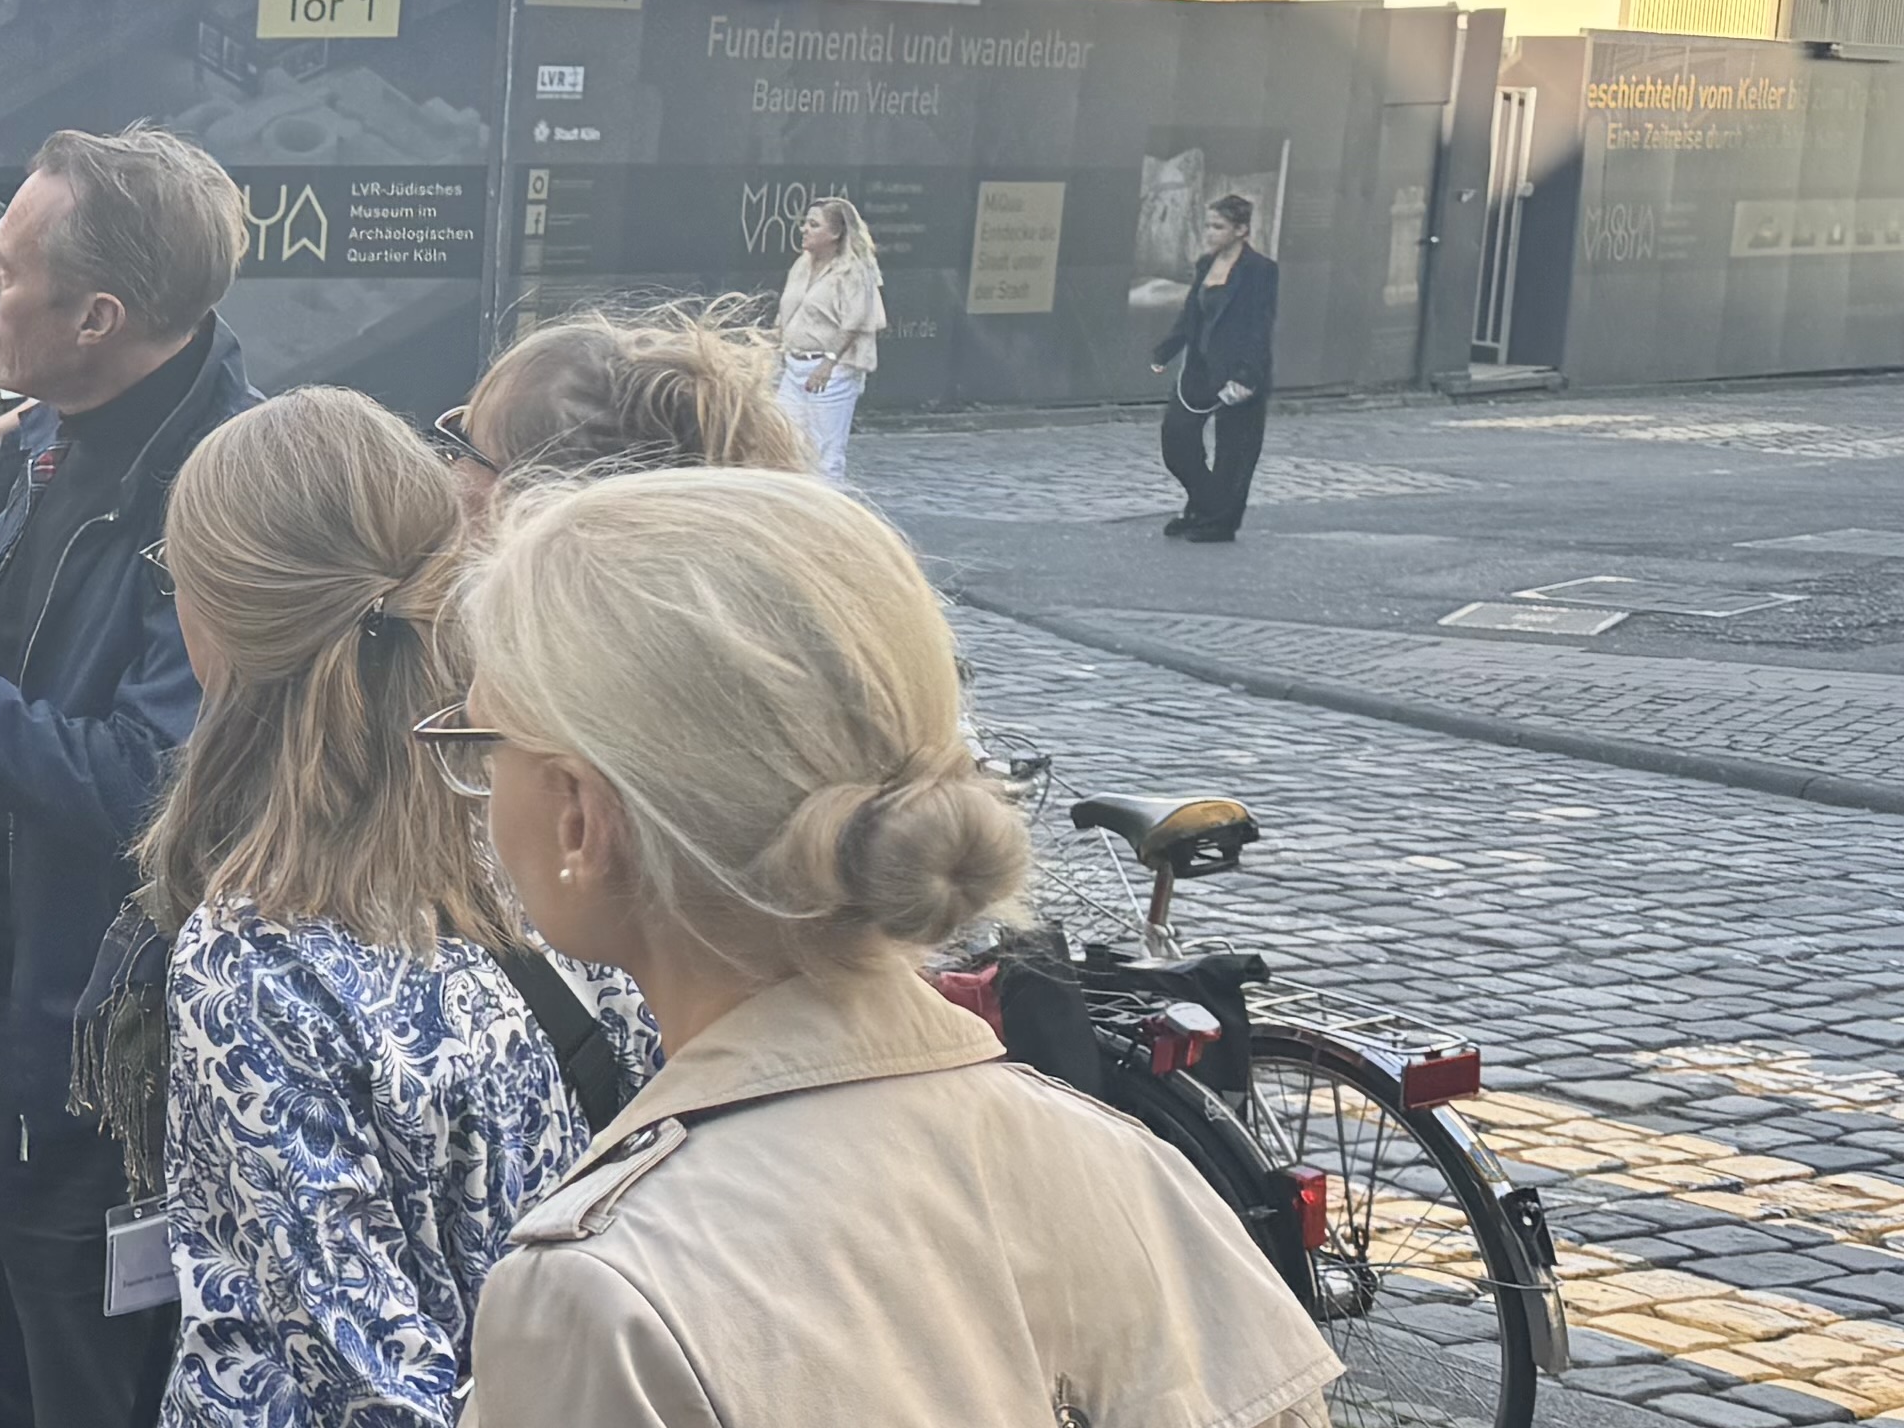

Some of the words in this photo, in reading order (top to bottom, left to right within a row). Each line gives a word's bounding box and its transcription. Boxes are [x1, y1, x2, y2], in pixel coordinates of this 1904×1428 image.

[707, 15, 895, 64] Fundamental
[903, 27, 954, 65] und
[961, 29, 1094, 70] wandelbar
[540, 71, 566, 87] LVR
[752, 79, 826, 113] Bauen
[832, 81, 859, 113] im
[866, 81, 940, 116] Viertel
[1587, 73, 1696, 112] eschichte(n)
[1699, 80, 1733, 110] vom
[1737, 77, 1787, 111] Keller
[1606, 122, 1640, 151] Eine
[1643, 122, 1703, 151] Zeitreise
[351, 181, 463, 197] LVR-Jüdisches
[350, 204, 414, 218] Museum
[418, 204, 437, 218] im
[348, 226, 474, 243] Archäologischen
[347, 248, 409, 264] Quartier
[413, 248, 447, 262] Köln
